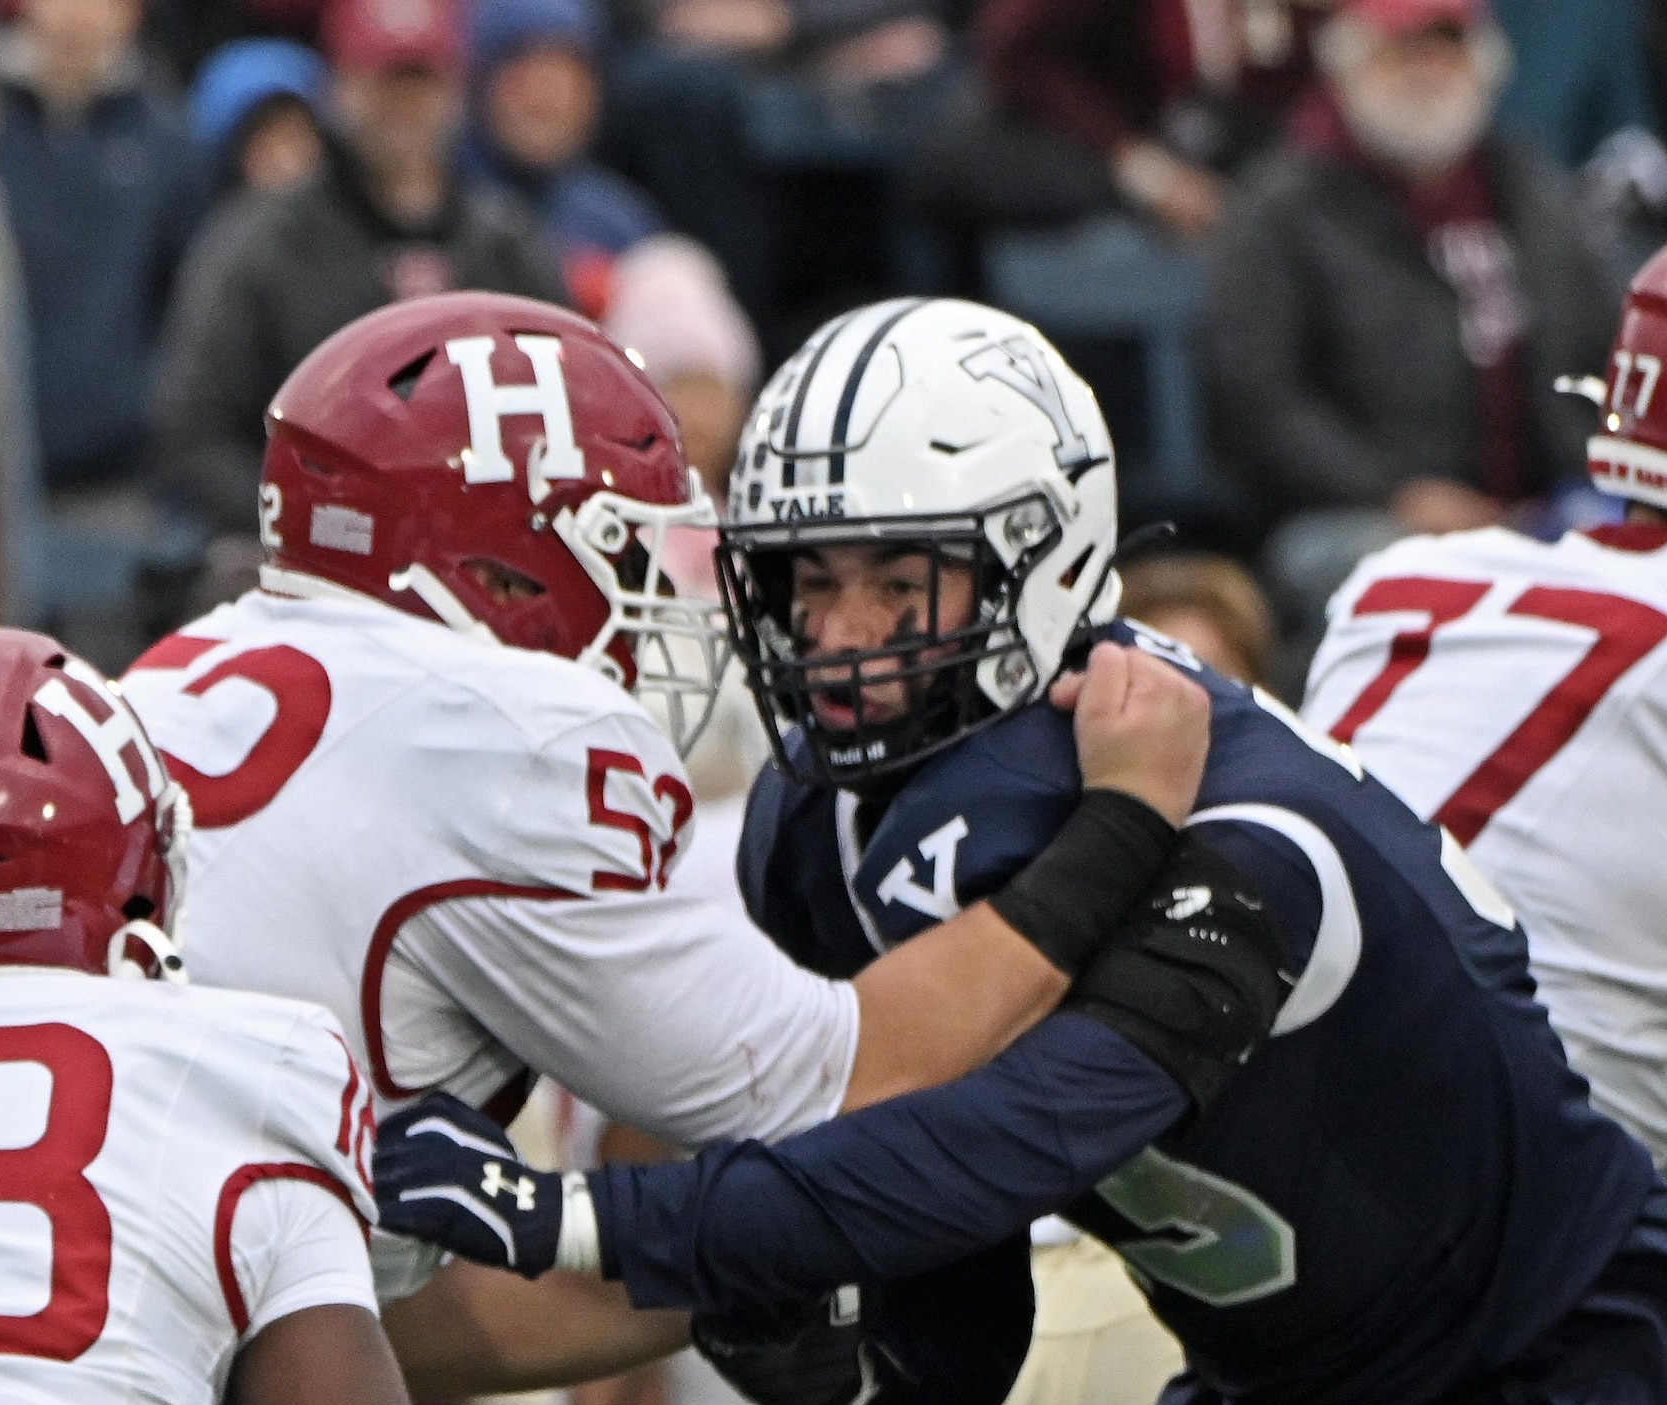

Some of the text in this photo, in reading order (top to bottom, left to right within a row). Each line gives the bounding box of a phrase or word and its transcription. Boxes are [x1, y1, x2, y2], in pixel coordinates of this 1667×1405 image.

[445, 335, 586, 484] H
[959, 335, 1092, 472] Y
[770, 493, 845, 521] YALE
[33, 660, 168, 826] H
[1327, 574, 1667, 850] 77
[586, 747, 694, 893] 52
